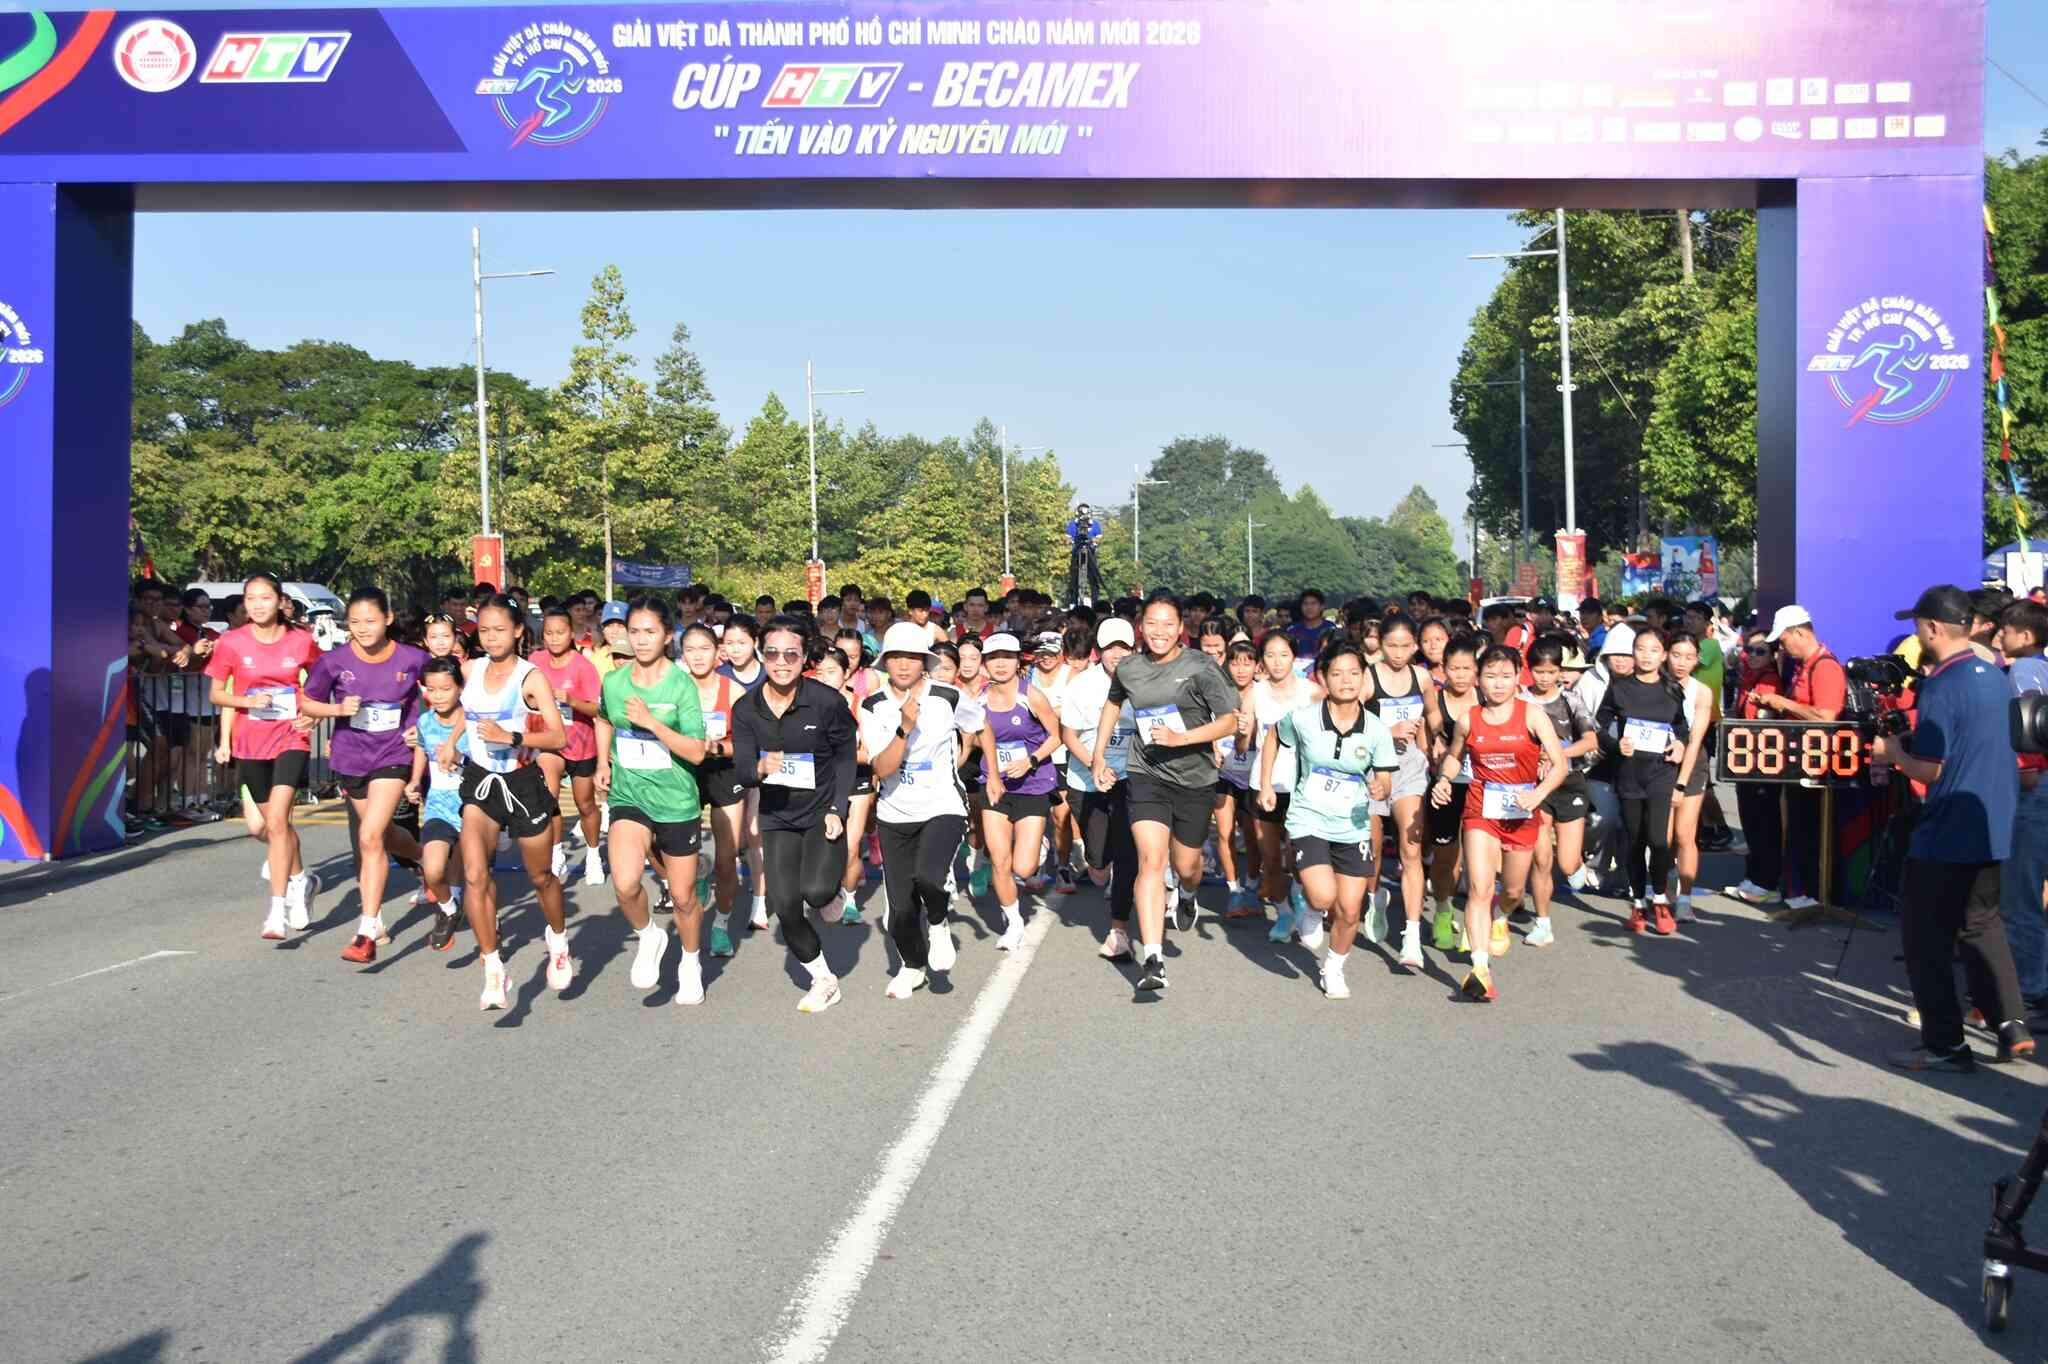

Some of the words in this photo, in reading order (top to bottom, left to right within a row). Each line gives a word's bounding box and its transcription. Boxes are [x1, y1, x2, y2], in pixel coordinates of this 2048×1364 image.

[612, 18, 651, 48] GIẢI
[656, 20, 699, 50] VIỆT
[737, 18, 803, 47] THÀNH
[809, 16, 850, 46] PHỐ
[888, 17, 921, 45] CHÍ
[927, 20, 980, 45] MINH
[986, 17, 1041, 45] CHÀO
[1146, 20, 1201, 45] 2026
[206, 38, 345, 77] HTV
[586, 77, 624, 94] 2026
[672, 54, 761, 109] CÚP
[767, 67, 897, 102] HTV
[932, 61, 1141, 108] BECAMEX
[735, 117, 794, 154] TIẾN
[798, 120, 853, 154] VÀO
[898, 119, 1011, 154] NGUYÊN
[372, 710, 379, 722] 5
[639, 743, 645, 756] 1
[1109, 735, 1124, 747] 67
[1324, 779, 1341, 793] 87
